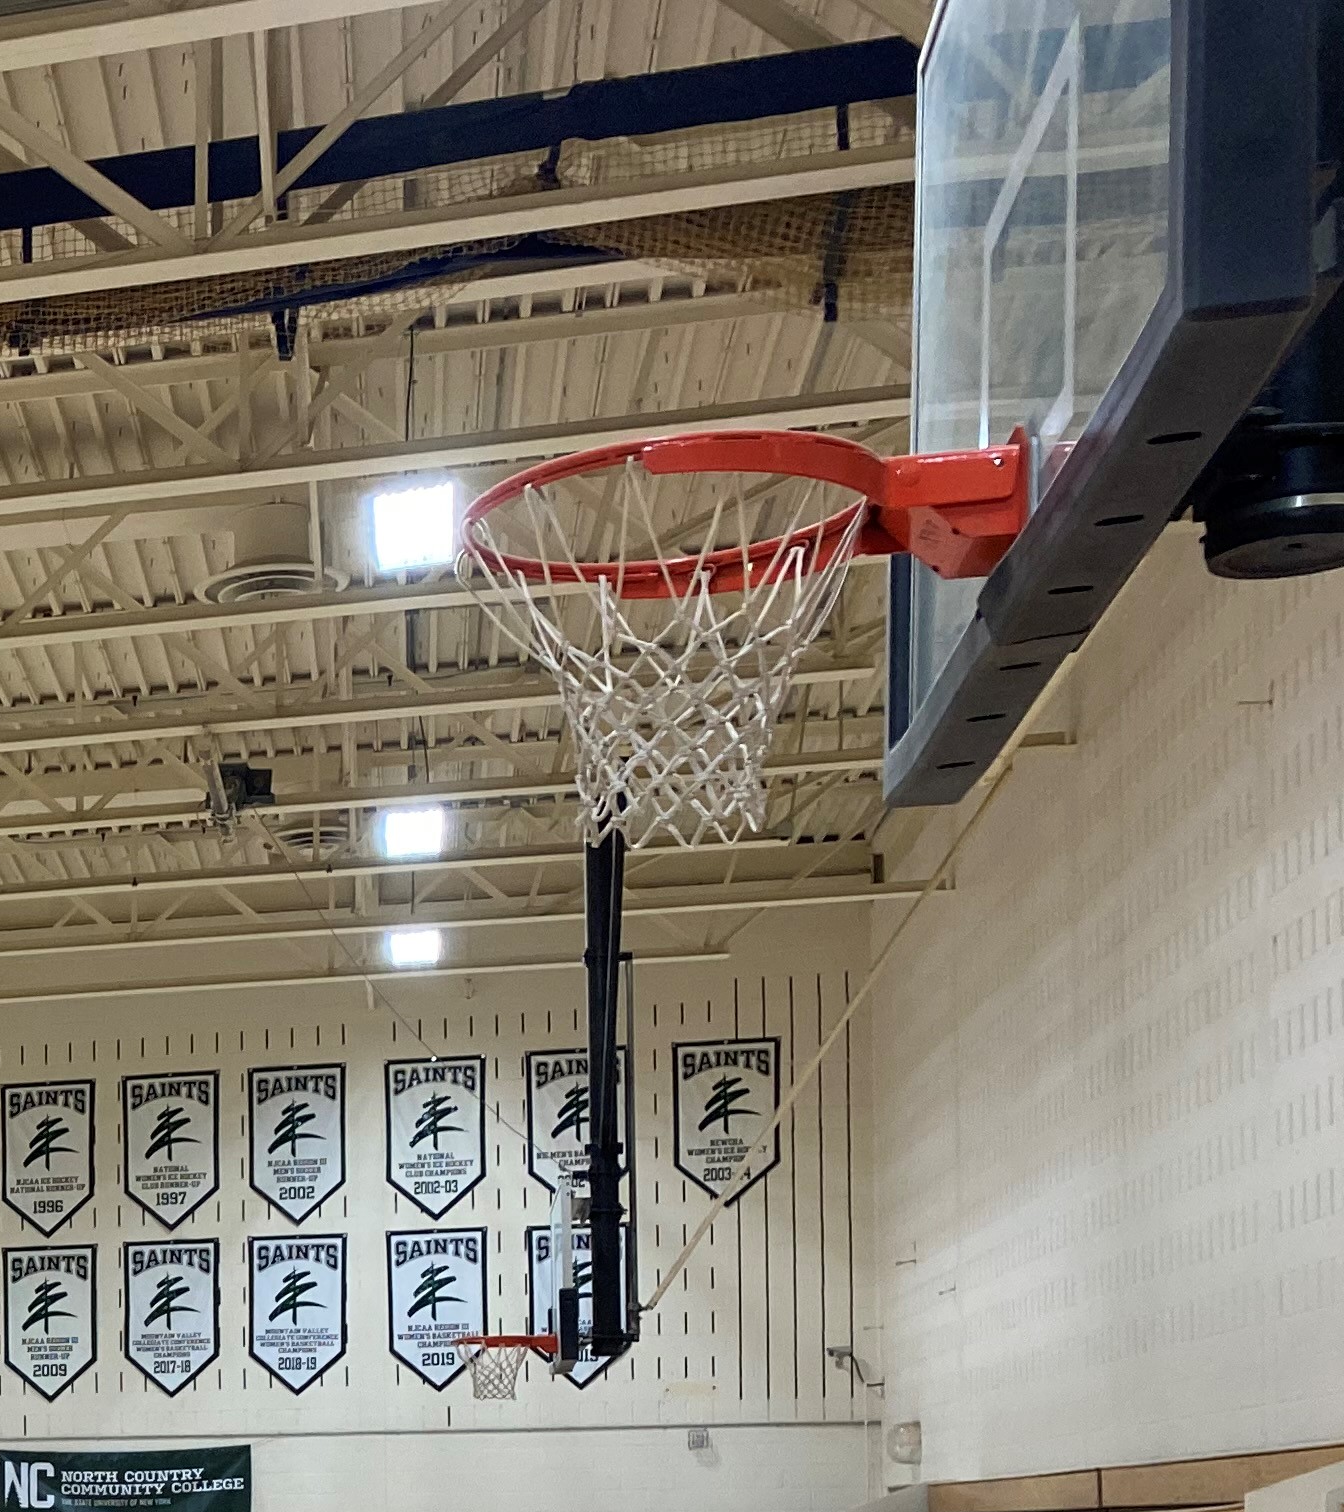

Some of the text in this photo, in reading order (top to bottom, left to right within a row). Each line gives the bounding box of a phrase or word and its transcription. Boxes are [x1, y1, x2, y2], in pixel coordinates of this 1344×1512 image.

[683, 1050, 770, 1081] SAINTS
[257, 1075, 336, 1105] SAINTS
[394, 1067, 475, 1095] SAINTS
[10, 1089, 86, 1118] SAINTS
[132, 1081, 209, 1110] SAINTS
[703, 1167, 751, 1181] 2003-4
[279, 1186, 315, 1200] 2002
[414, 1180, 458, 1194] 2002-03
[33, 1200, 63, 1214] 1996
[156, 1192, 187, 1206] 1997
[257, 1245, 338, 1272] SAINTS
[395, 1238, 477, 1267] SAINTS
[12, 1256, 88, 1283] SAINTS
[133, 1249, 211, 1276] SAINTS
[154, 1360, 191, 1374] 2017-18
[278, 1357, 317, 1370] 2018-19
[422, 1352, 454, 1366] 2019
[33, 1364, 67, 1377] 2009
[61, 1468, 204, 1483] NORTH COUNTRY
[5, 1461, 54, 1509] NC
[61, 1478, 244, 1496] COMMUNITY COLLEGE
